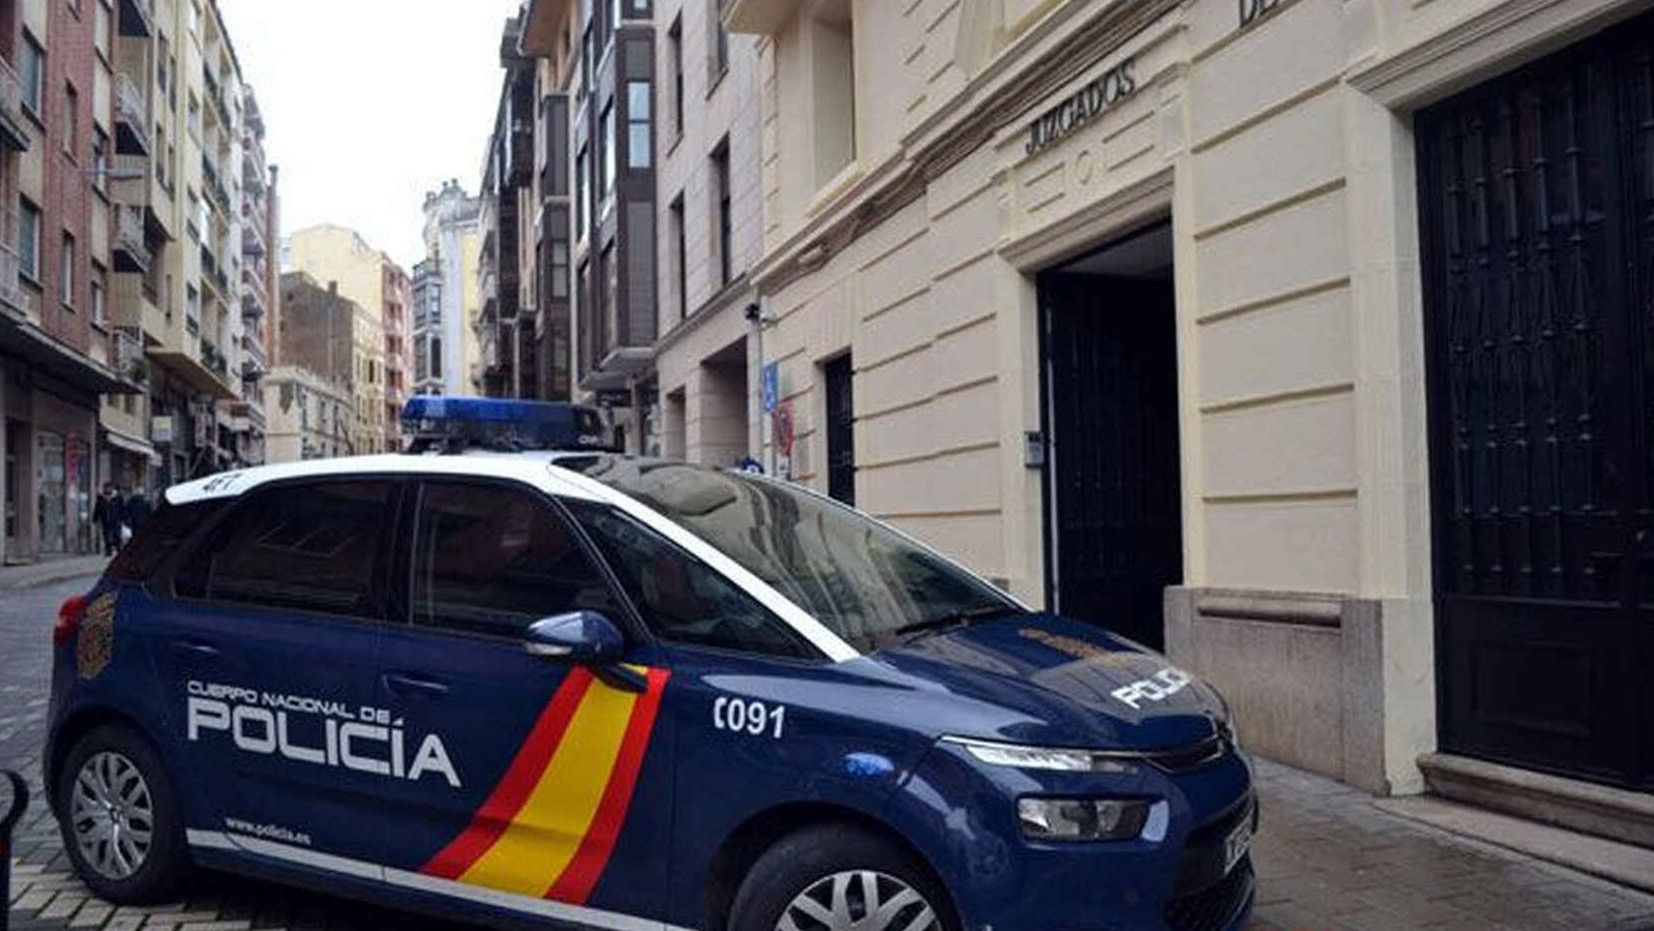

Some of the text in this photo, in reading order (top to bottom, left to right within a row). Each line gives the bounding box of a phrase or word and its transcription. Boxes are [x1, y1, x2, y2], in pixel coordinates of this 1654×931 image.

[1026, 57, 1135, 154] JUZGADOS
[187, 680, 390, 724] CUERPO NACIONAL DE
[187, 697, 461, 787] POLICÍA
